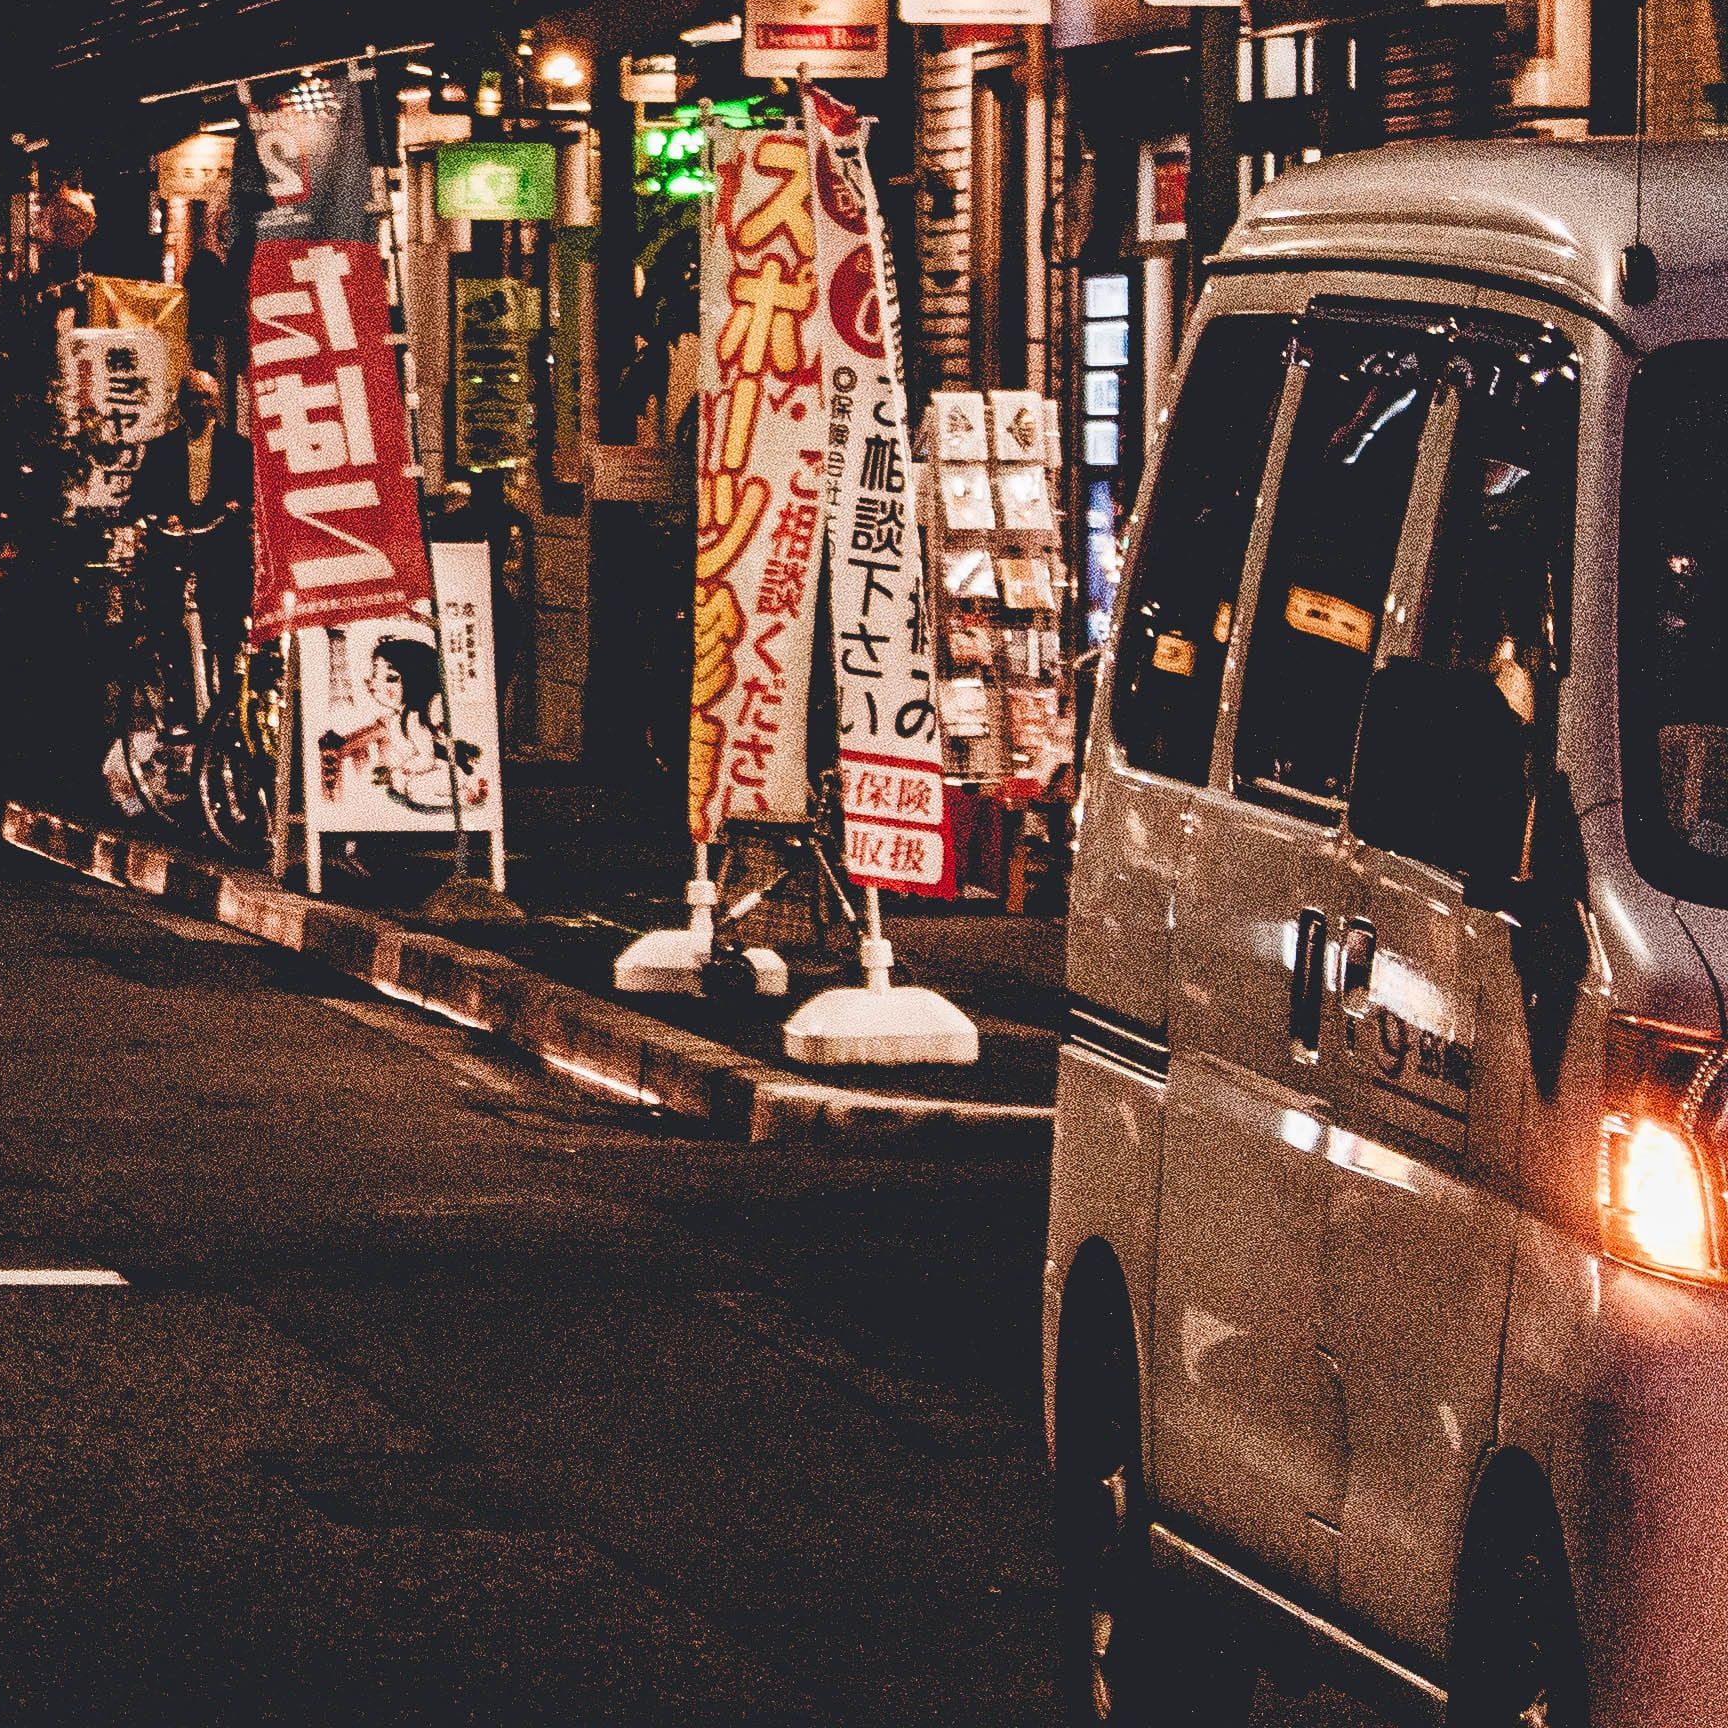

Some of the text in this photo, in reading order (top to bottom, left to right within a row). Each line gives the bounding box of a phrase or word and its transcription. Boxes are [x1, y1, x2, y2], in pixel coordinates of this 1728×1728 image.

[721, 448, 822, 815] ご相談ください
[851, 769, 932, 816] 保険
[848, 830, 926, 875] 取扱
